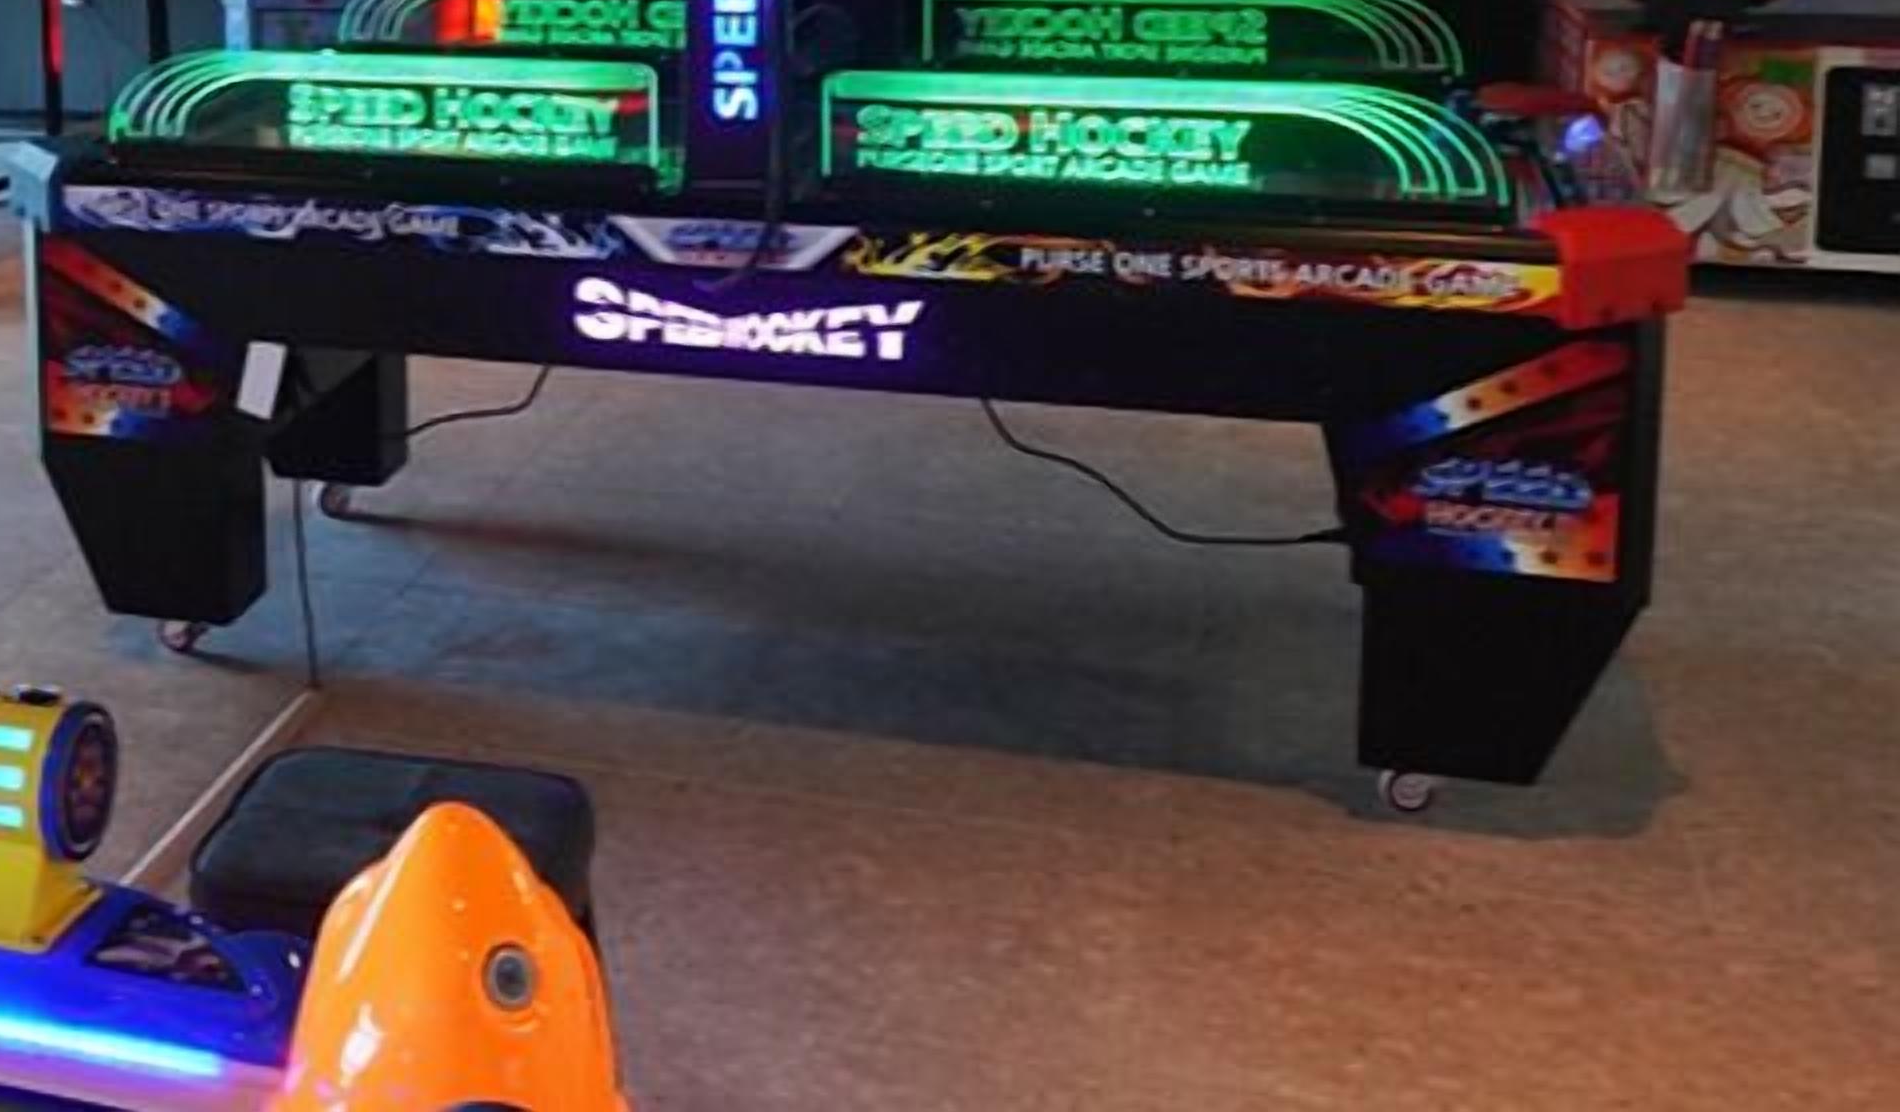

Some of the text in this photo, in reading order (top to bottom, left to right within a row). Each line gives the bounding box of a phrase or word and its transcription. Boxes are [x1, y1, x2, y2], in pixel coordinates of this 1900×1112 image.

[287, 83, 428, 125] SPEED
[856, 103, 1252, 161] SPEED HOCKEY
[1113, 251, 1171, 278] ONE
